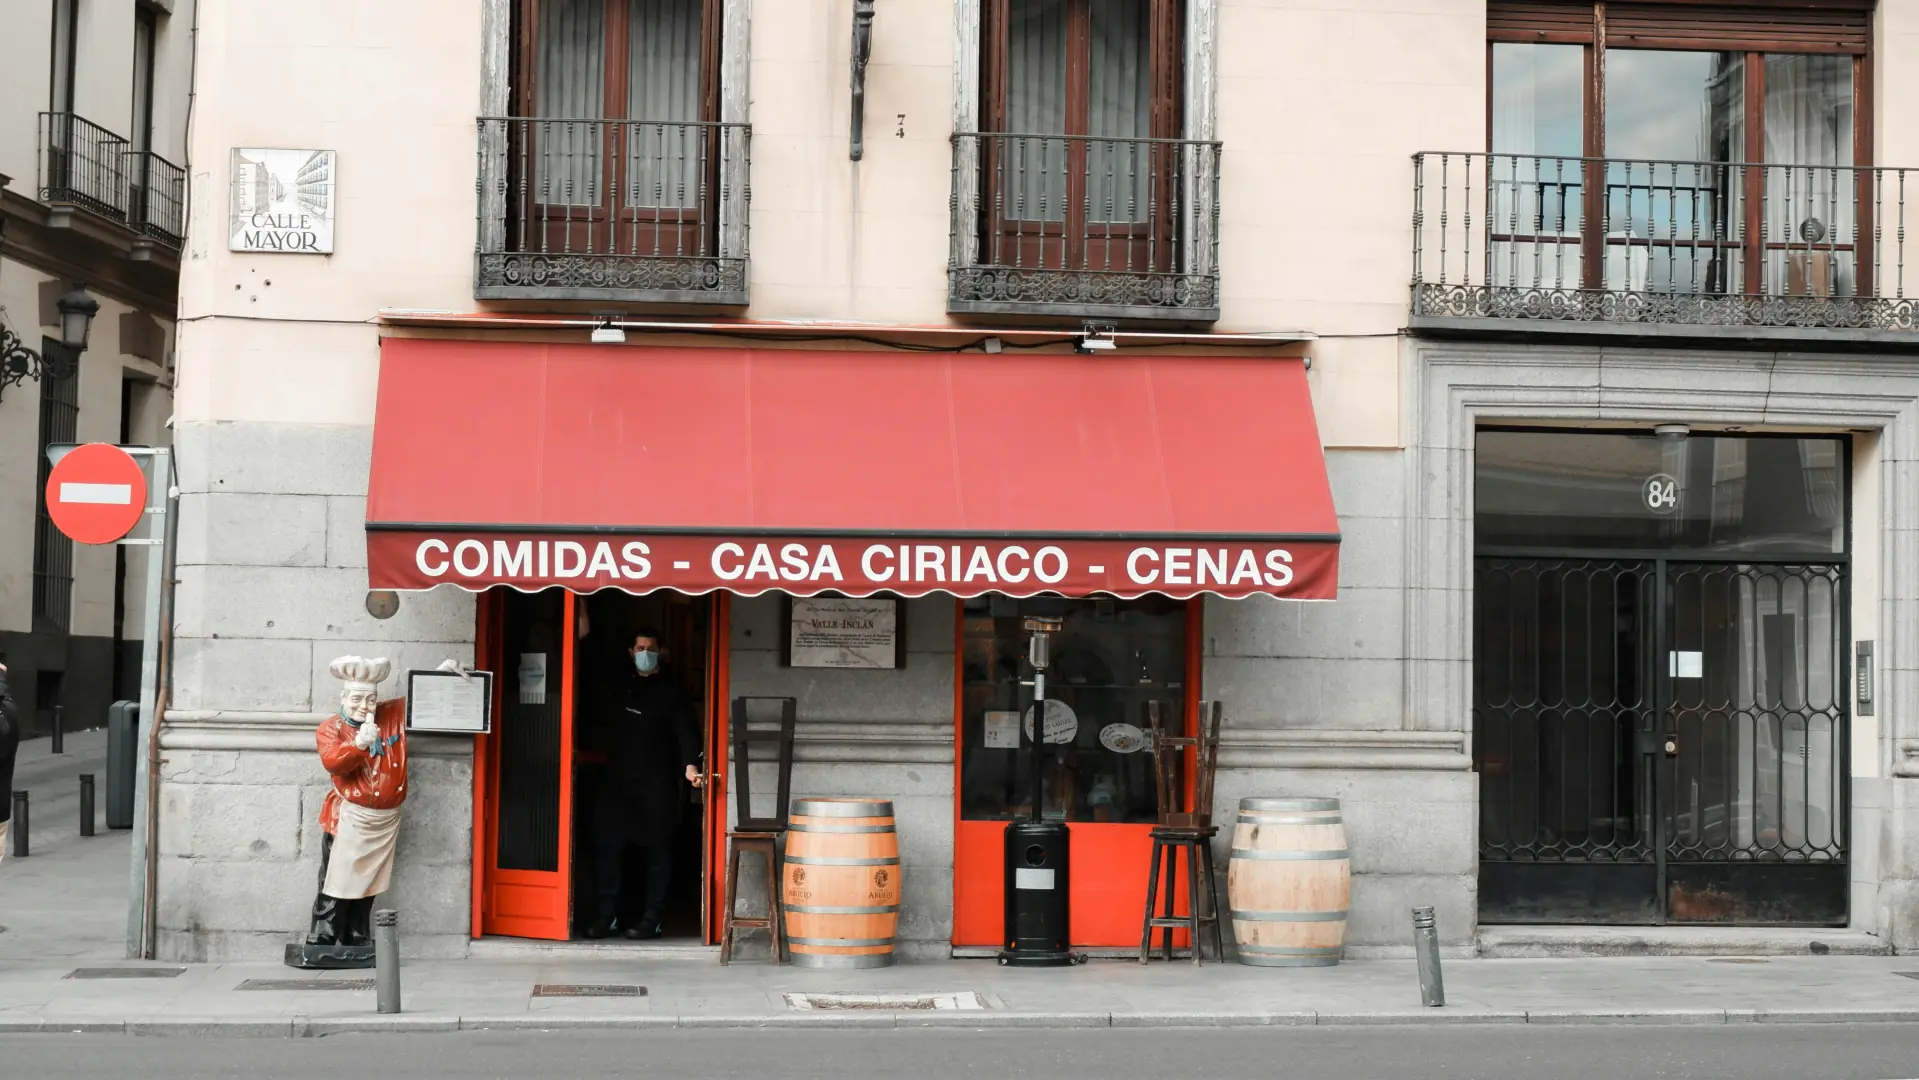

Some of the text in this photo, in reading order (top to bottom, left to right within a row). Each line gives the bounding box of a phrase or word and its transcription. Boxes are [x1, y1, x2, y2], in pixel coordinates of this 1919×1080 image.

[251, 213, 311, 229] CALLE
[244, 230, 321, 252] MAYOR
[1648, 480, 1676, 507] 84
[415, 538, 652, 580] COMIDAS
[711, 542, 844, 582] CASA
[860, 544, 1069, 584] CIRIACO
[1126, 547, 1294, 587] CENAS
